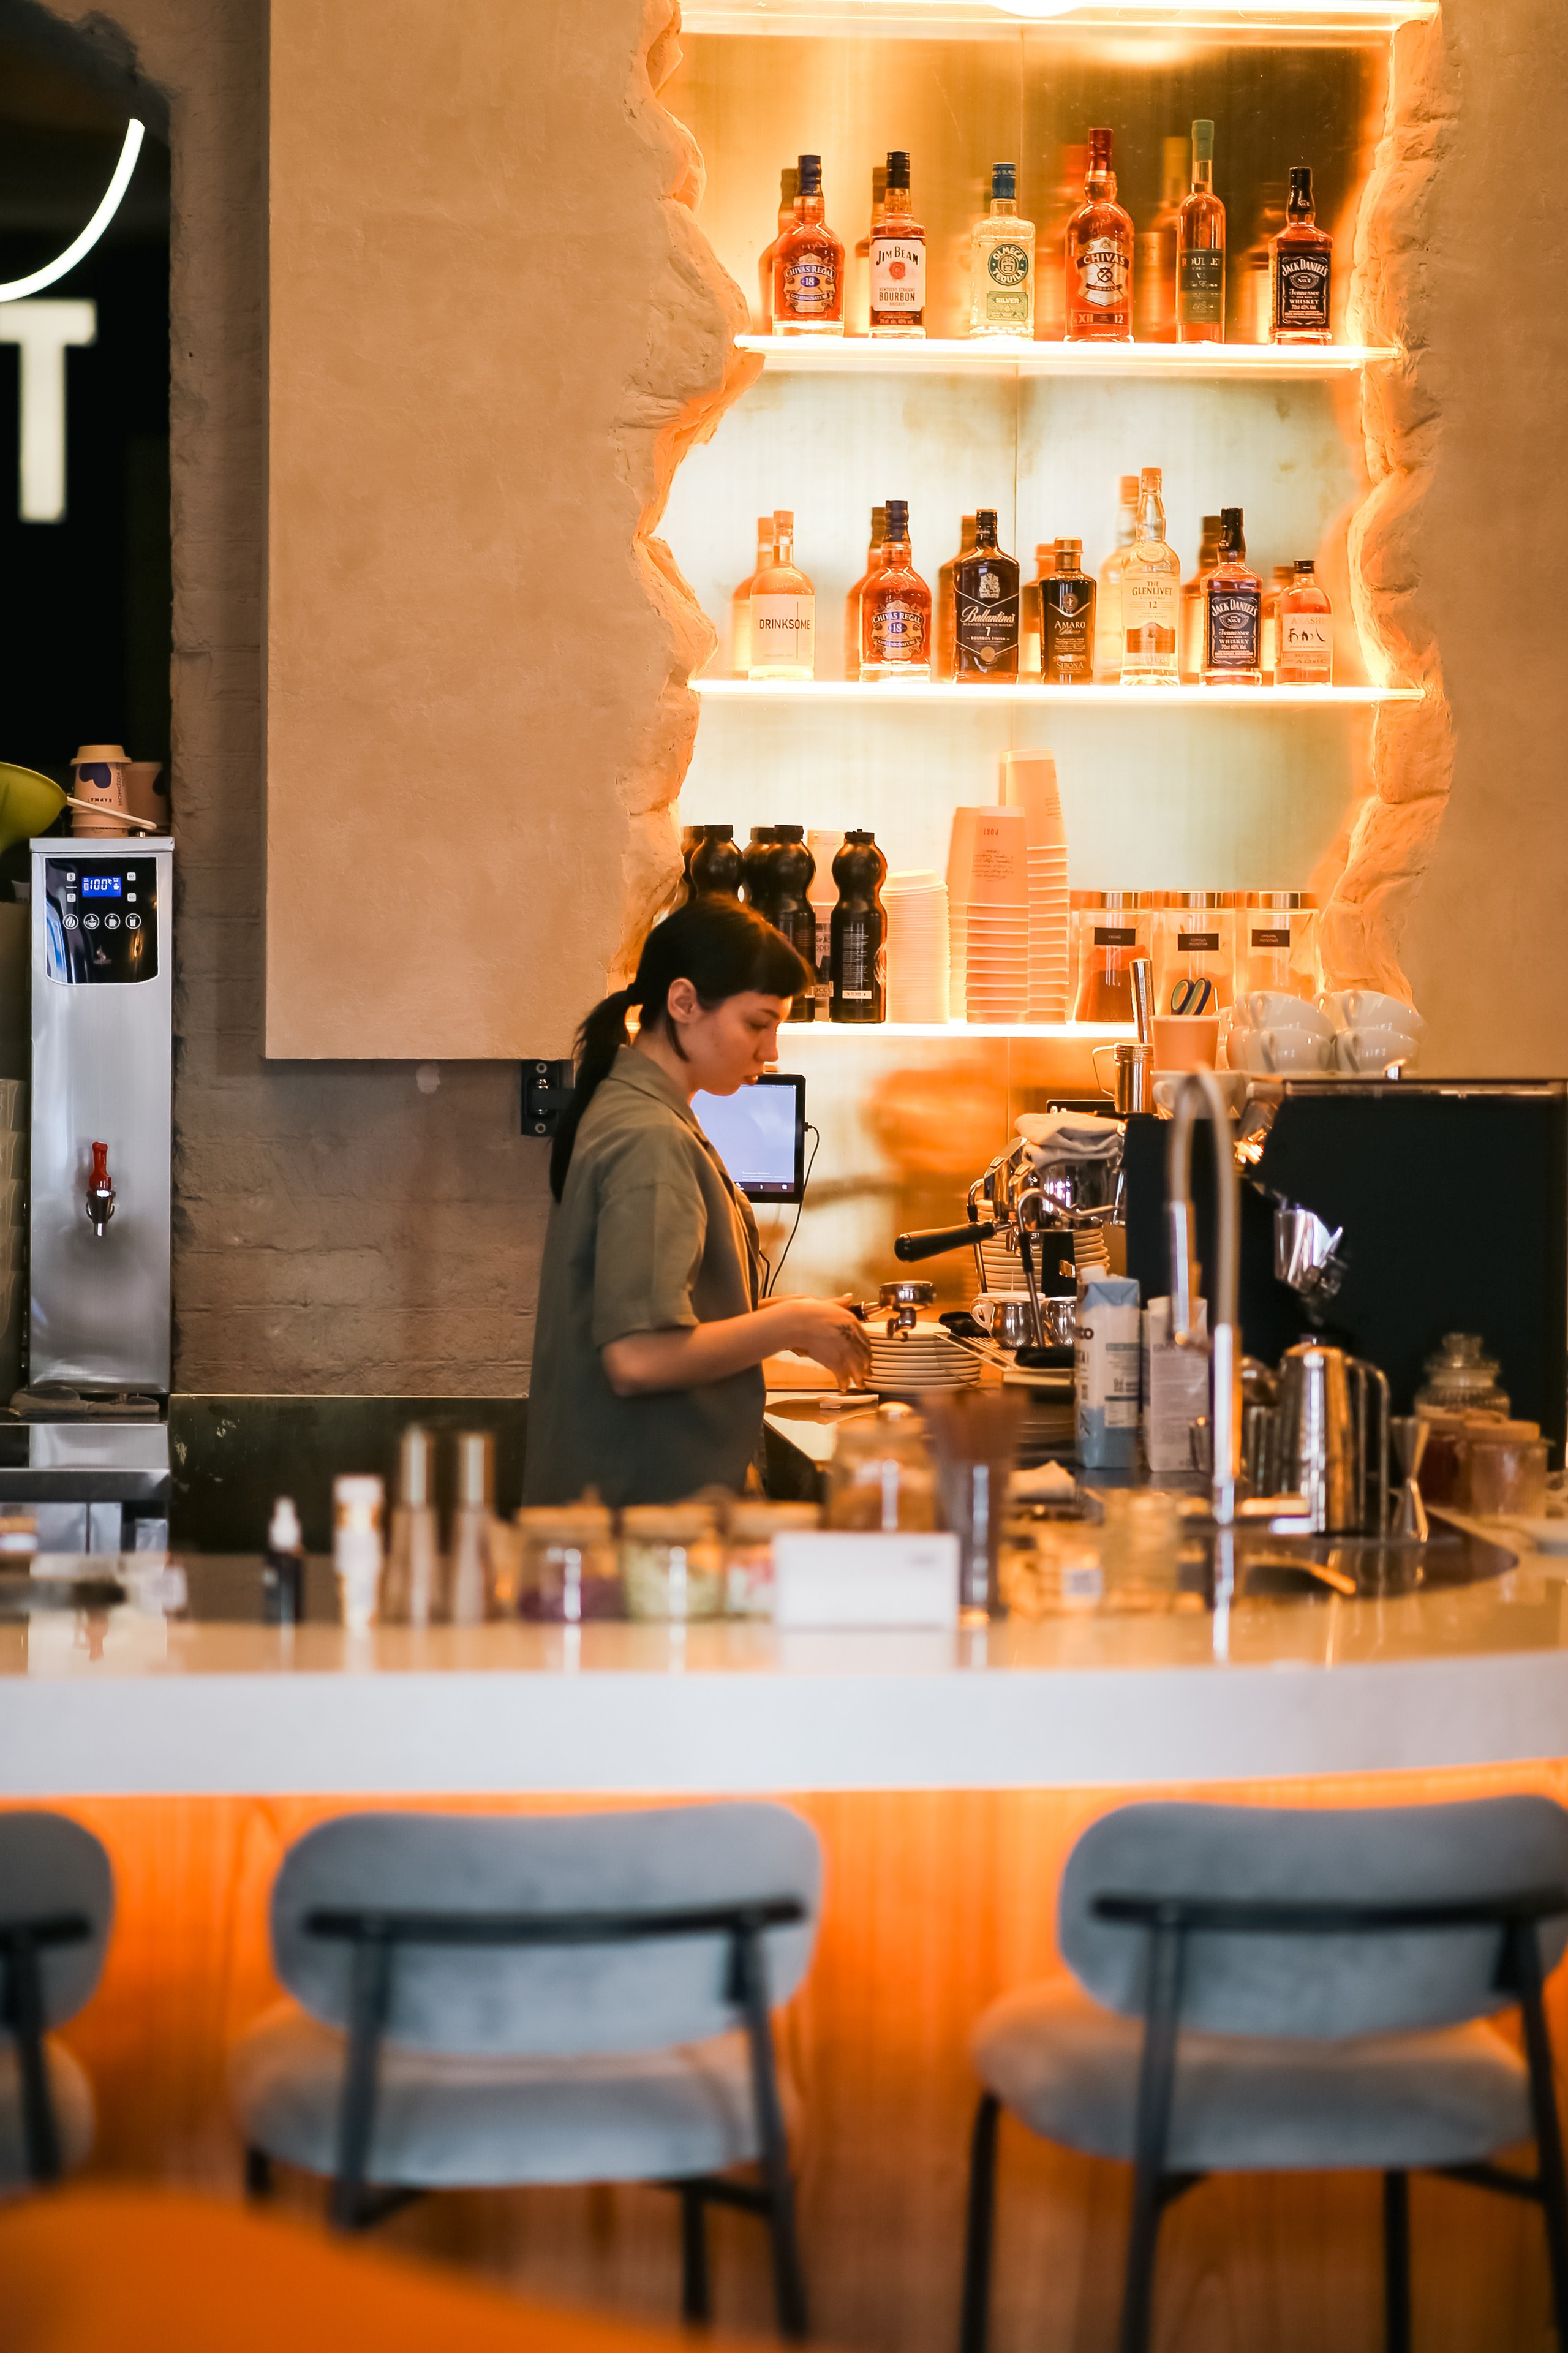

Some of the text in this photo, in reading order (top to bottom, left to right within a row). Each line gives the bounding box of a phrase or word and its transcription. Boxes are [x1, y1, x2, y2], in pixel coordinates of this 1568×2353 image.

[876, 246, 918, 266] JIM BEAM
[992, 246, 1024, 262] OLMECA
[1083, 253, 1125, 265] CHIVAS
[785, 265, 834, 278] CHIVAS REGAL
[1281, 262, 1300, 276] JACK
[805, 277, 815, 286] 18
[992, 268, 1025, 283] TEQUILA
[879, 292, 915, 301] BOURBON
[1078, 314, 1093, 323] XII
[1114, 314, 1124, 323] 12
[1132, 587, 1172, 596] GLENLIVET
[1211, 602, 1230, 617] JACK
[873, 612, 921, 624] CHIVAS REGAL
[760, 619, 810, 630] DRINKSOME
[892, 624, 902, 632] 18
[986, 627, 991, 636] 7
